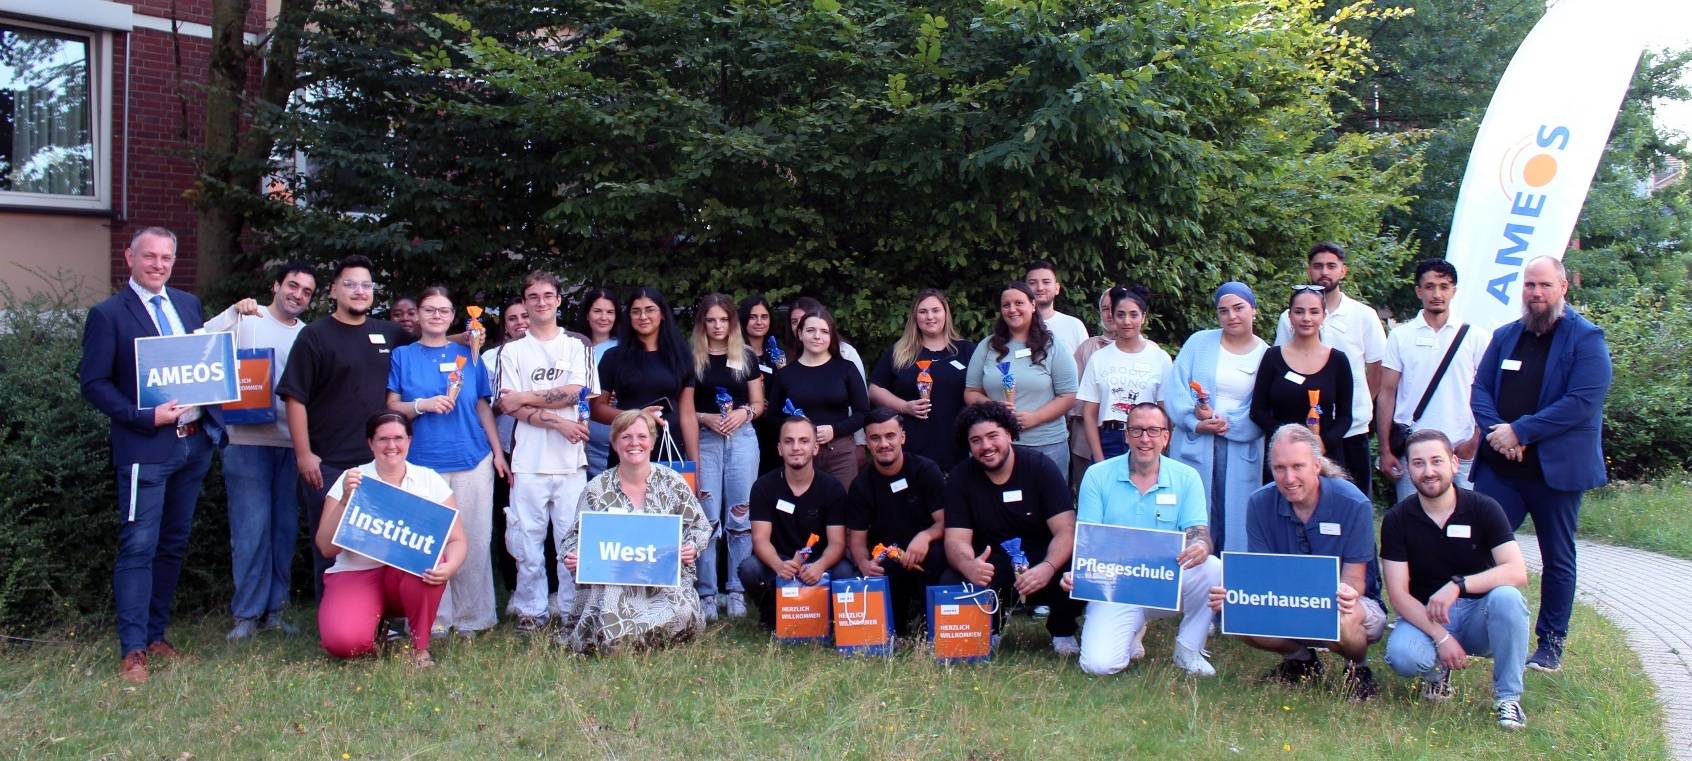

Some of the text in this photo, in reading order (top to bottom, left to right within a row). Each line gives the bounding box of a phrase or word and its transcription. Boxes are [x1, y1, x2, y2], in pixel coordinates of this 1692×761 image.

[147, 362, 225, 388] AMEOS
[348, 505, 436, 555] Institut
[599, 541, 657, 563] West
[1076, 557, 1175, 581] Pflegeschule
[1226, 589, 1332, 609] Oberhausen
